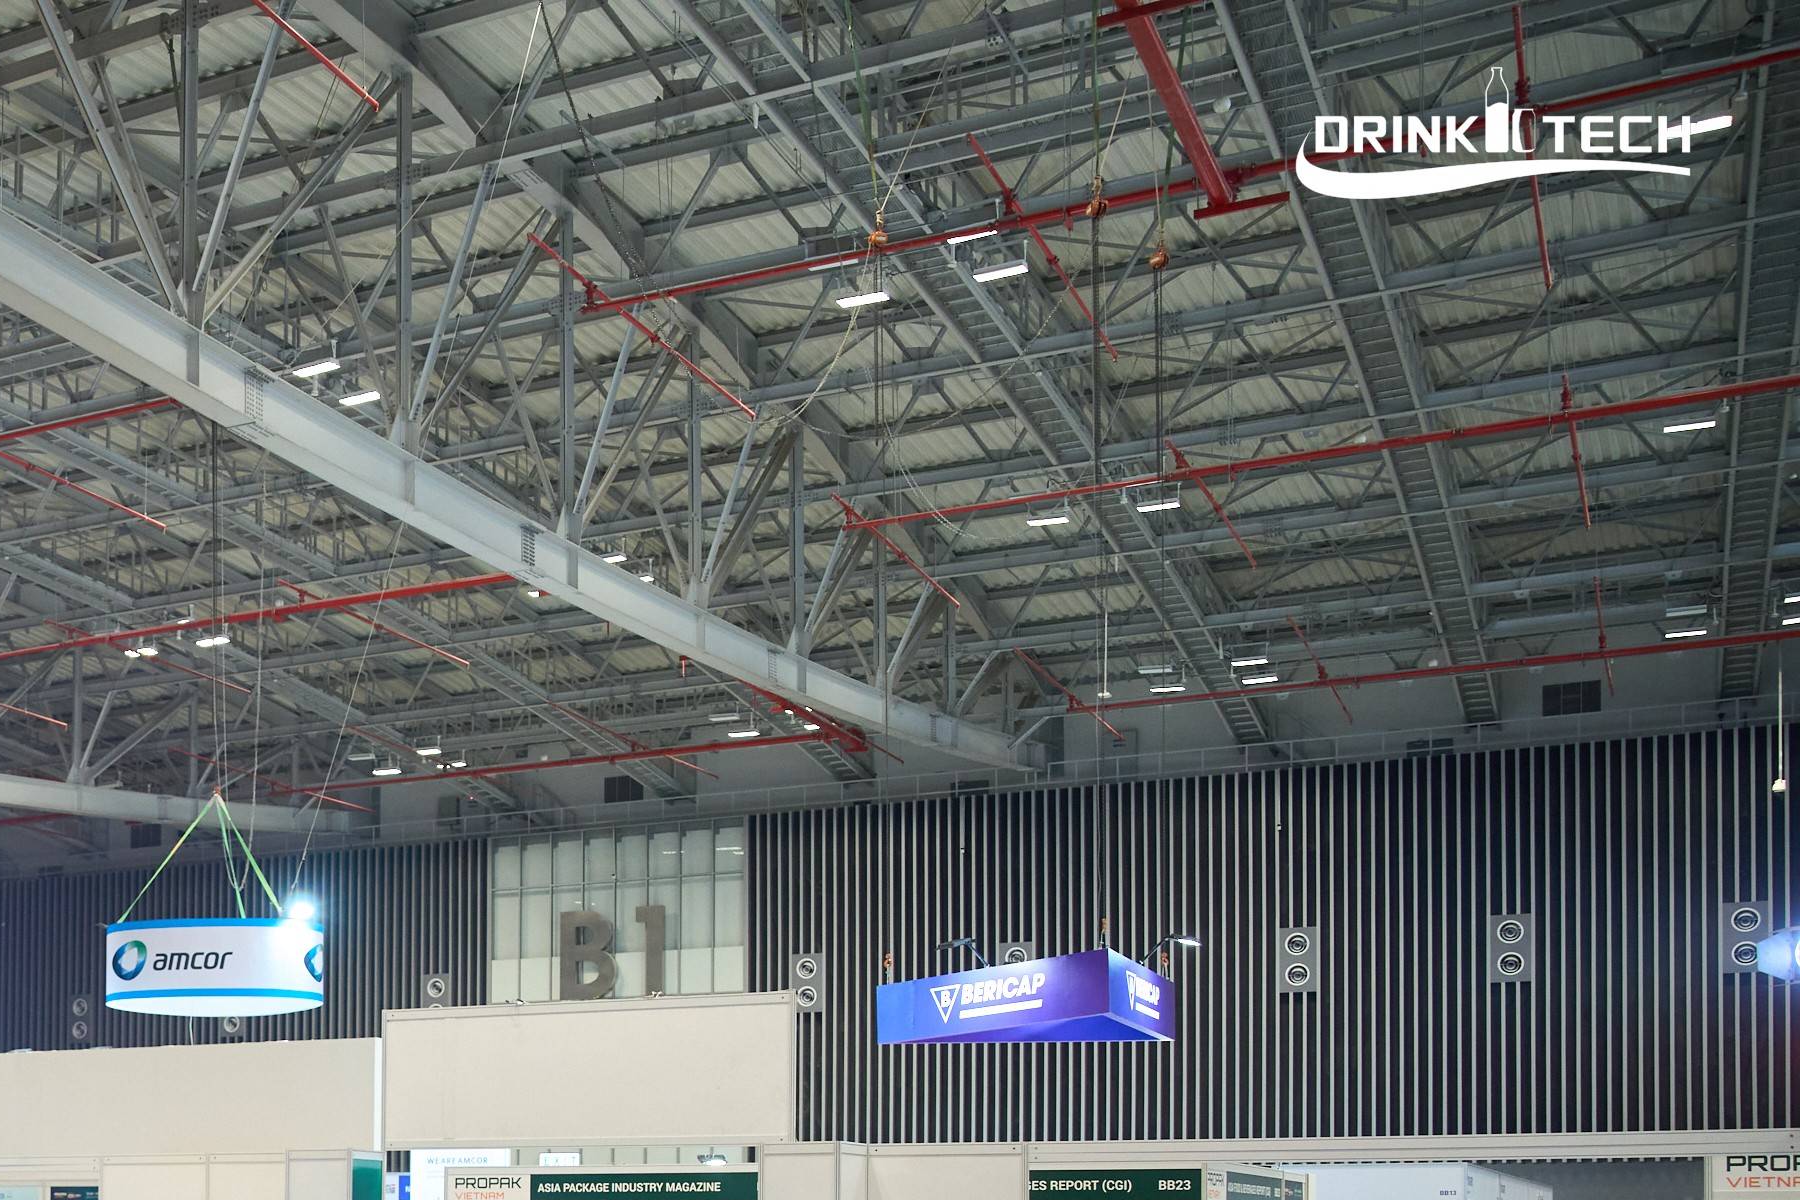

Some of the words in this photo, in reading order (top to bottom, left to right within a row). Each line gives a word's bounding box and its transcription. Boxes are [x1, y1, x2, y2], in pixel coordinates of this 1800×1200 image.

[560, 905, 666, 1001] B1
[153, 951, 234, 971] amcor
[959, 972, 1046, 1005] BERICAP
[457, 1156, 488, 1164] AMCOR
[454, 1177, 523, 1189] PROPAK
[537, 1182, 562, 1193] ASIA
[563, 1182, 610, 1193] PACKAGE
[611, 1182, 664, 1193] INDUSTRY
[665, 1181, 722, 1193] MAGAZINE
[1050, 1179, 1099, 1191] REPORT
[1102, 1179, 1133, 1193] (CGI)
[1158, 1179, 1192, 1191] BB23
[454, 1191, 505, 1200] VIETNAM
